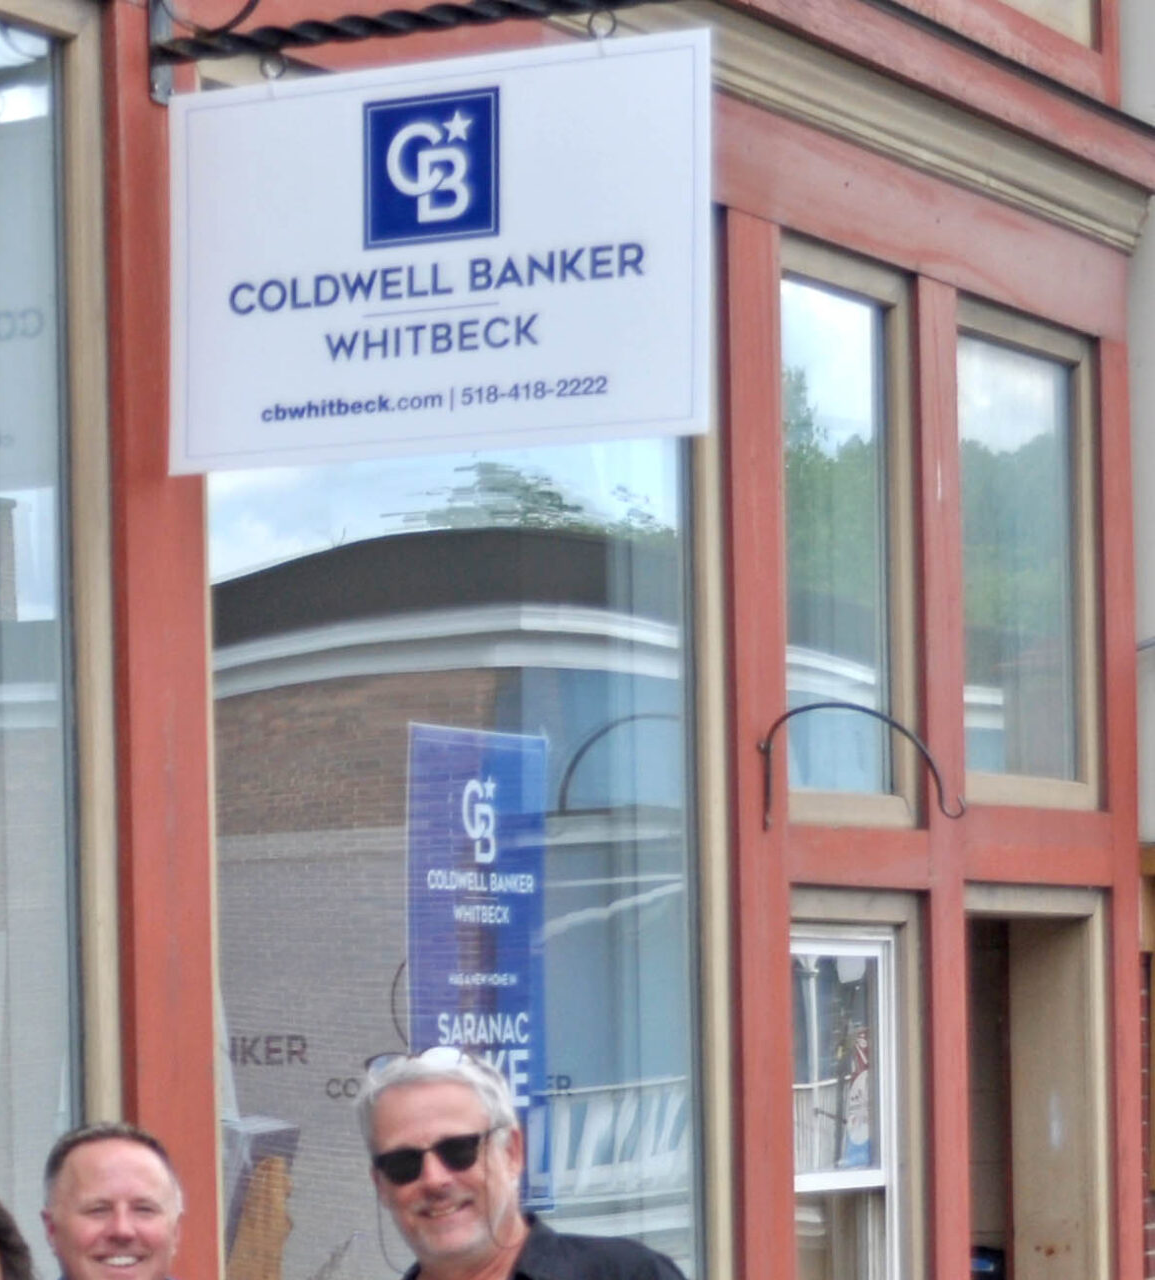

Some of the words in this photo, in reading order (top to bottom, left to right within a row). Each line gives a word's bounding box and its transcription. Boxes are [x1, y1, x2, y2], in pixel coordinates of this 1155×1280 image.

[386, 121, 471, 223] CB
[229, 262, 453, 315] COLDWELL
[469, 242, 644, 294] BANKER
[325, 313, 539, 362] WHITBECK
[261, 389, 443, 423] cbwhitbeck.com
[460, 375, 608, 407] 518-418-2222
[427, 870, 488, 892] COLDWELL
[490, 873, 534, 893] BANKER
[453, 905, 510, 924] WHITBECK
[438, 1012, 529, 1044] SARANAC
